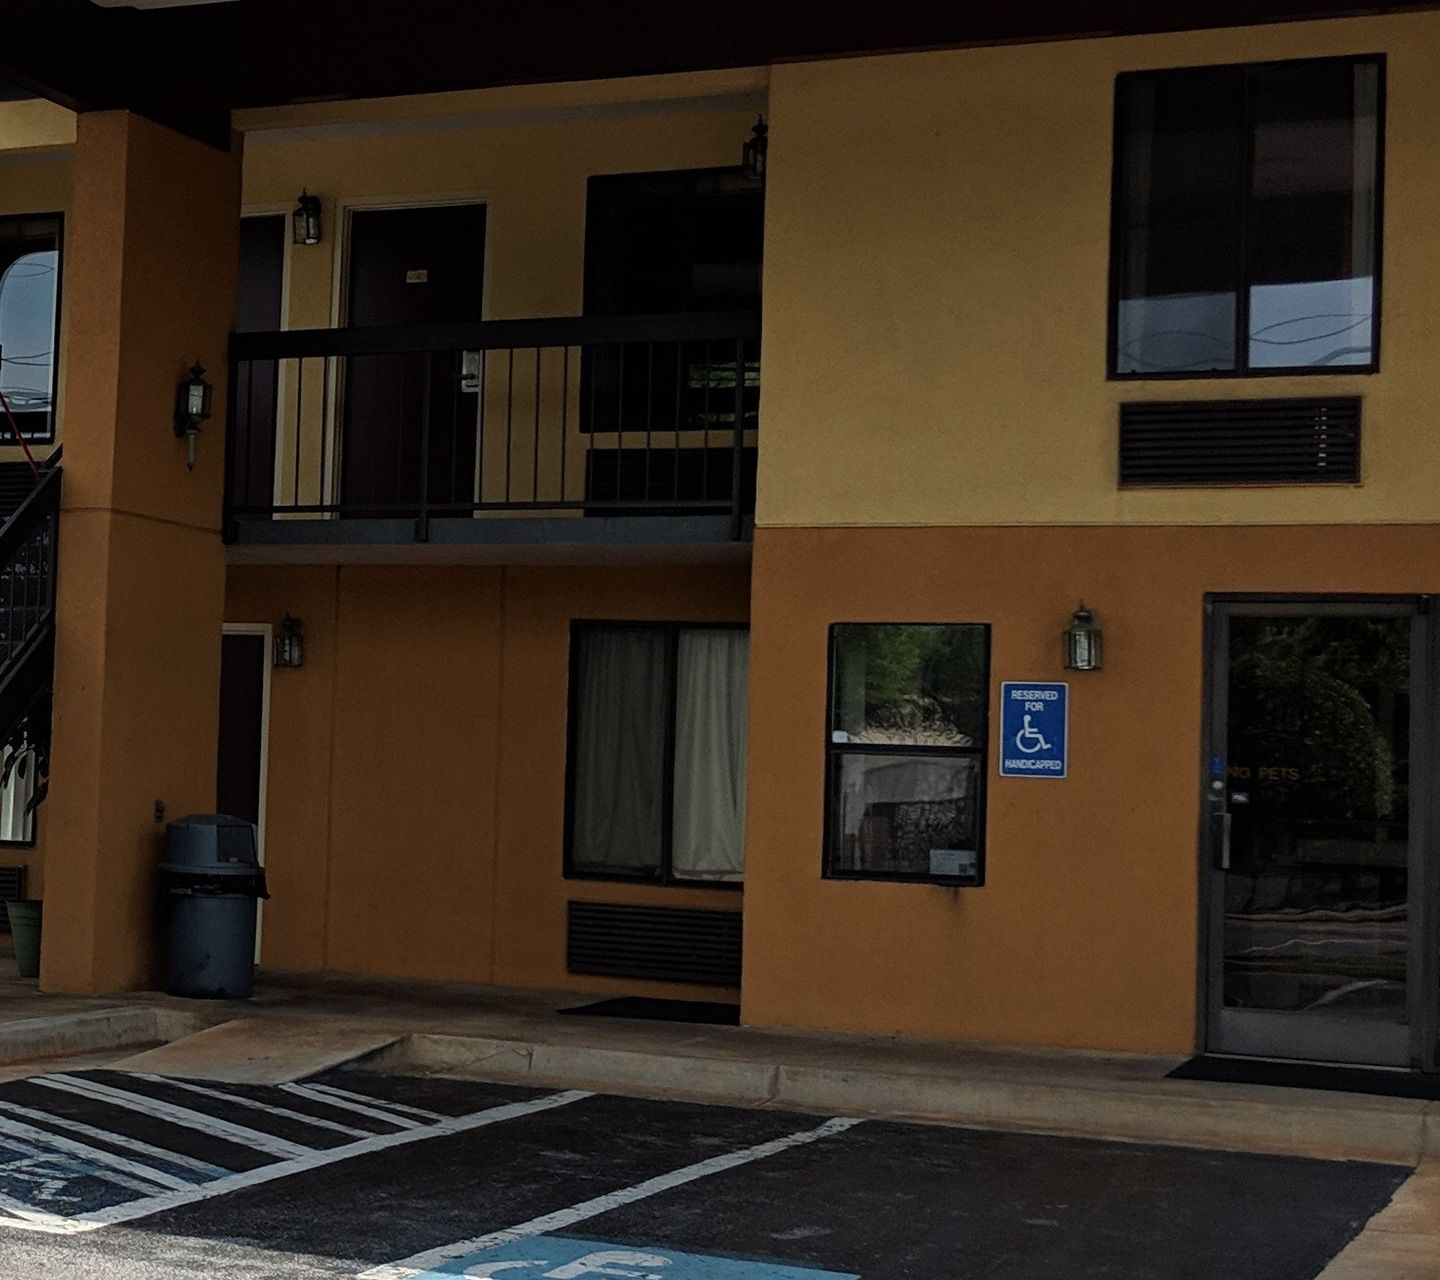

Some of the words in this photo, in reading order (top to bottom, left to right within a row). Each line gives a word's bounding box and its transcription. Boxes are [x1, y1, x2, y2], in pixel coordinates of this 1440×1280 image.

[1011, 690, 1059, 701] RESERVED
[1024, 701, 1045, 712] FOR
[1004, 759, 1063, 770] HANDICAPPED
